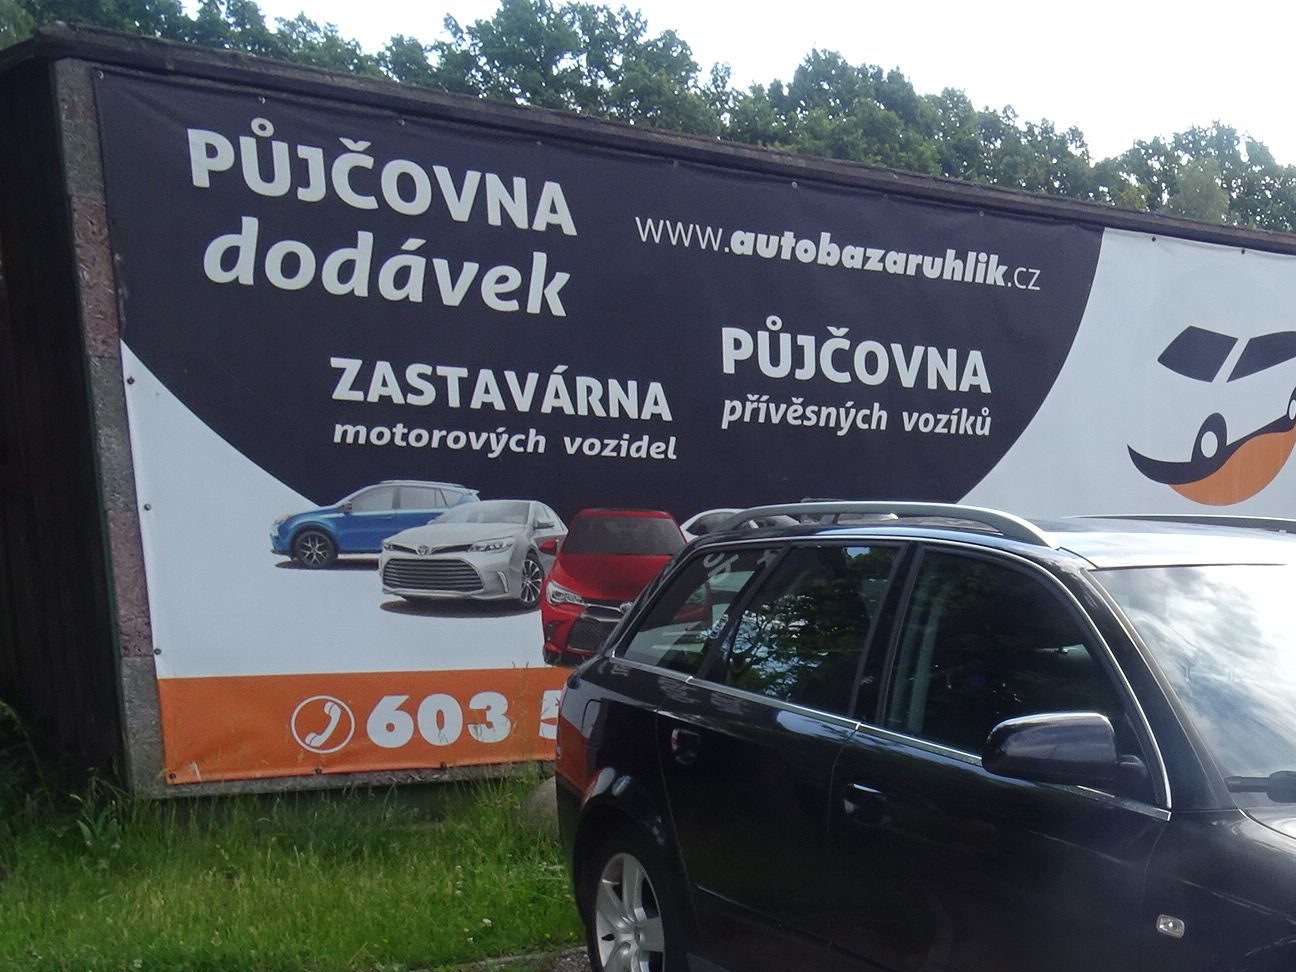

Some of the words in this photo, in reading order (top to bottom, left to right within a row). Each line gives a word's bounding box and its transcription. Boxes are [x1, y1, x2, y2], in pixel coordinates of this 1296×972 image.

[186, 117, 578, 236] PŮJČOVNA
[203, 215, 571, 318] dodávek
[634, 216, 1042, 291] www.autobazaruhlik.cz
[329, 356, 674, 422] ZASTAVÁRNA
[721, 315, 992, 394] PŮJČOVNA
[332, 422, 547, 459] motorových
[563, 433, 678, 461] vozidel
[721, 393, 889, 437] přívěsných
[902, 406, 992, 437] vozíků
[366, 690, 513, 749] 603
